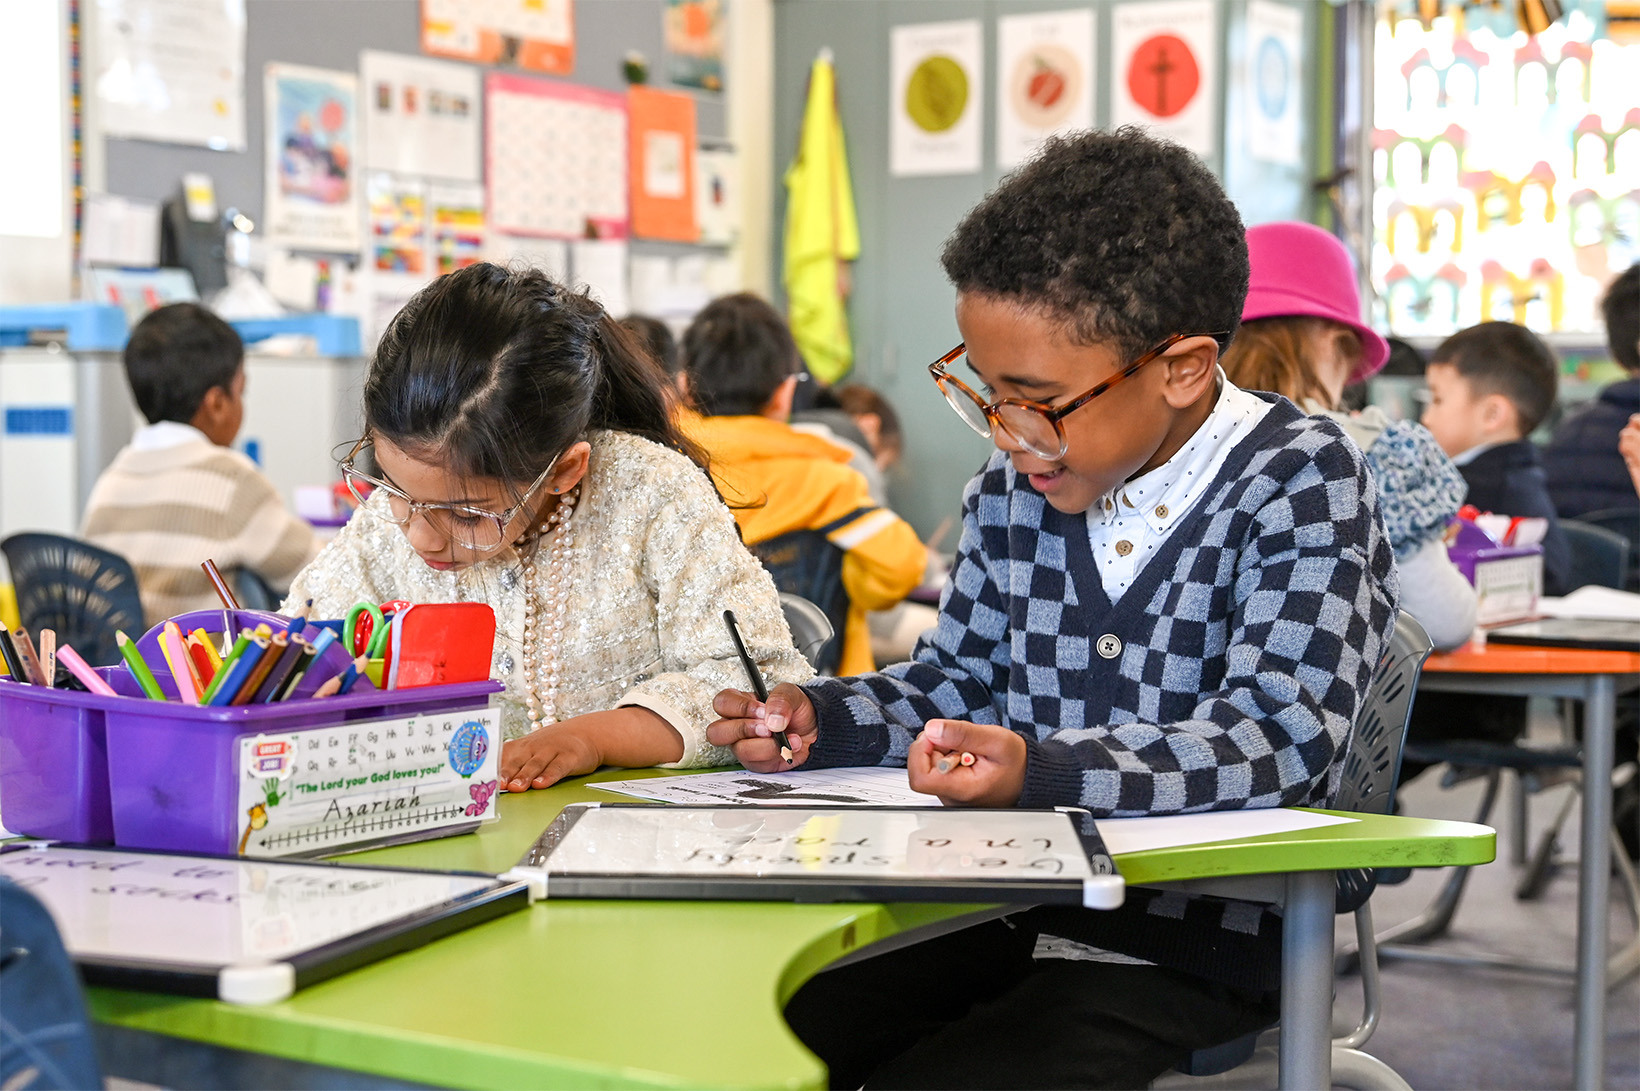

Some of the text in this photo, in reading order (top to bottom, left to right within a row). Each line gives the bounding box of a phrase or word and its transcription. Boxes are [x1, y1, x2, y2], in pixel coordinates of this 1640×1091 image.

[321, 778, 344, 791] Lord
[346, 776, 368, 789] your
[370, 770, 391, 783] God
[392, 768, 417, 780] loves
[323, 786, 420, 824] Azariah
[919, 837, 953, 848] a
[980, 837, 1052, 849] in
